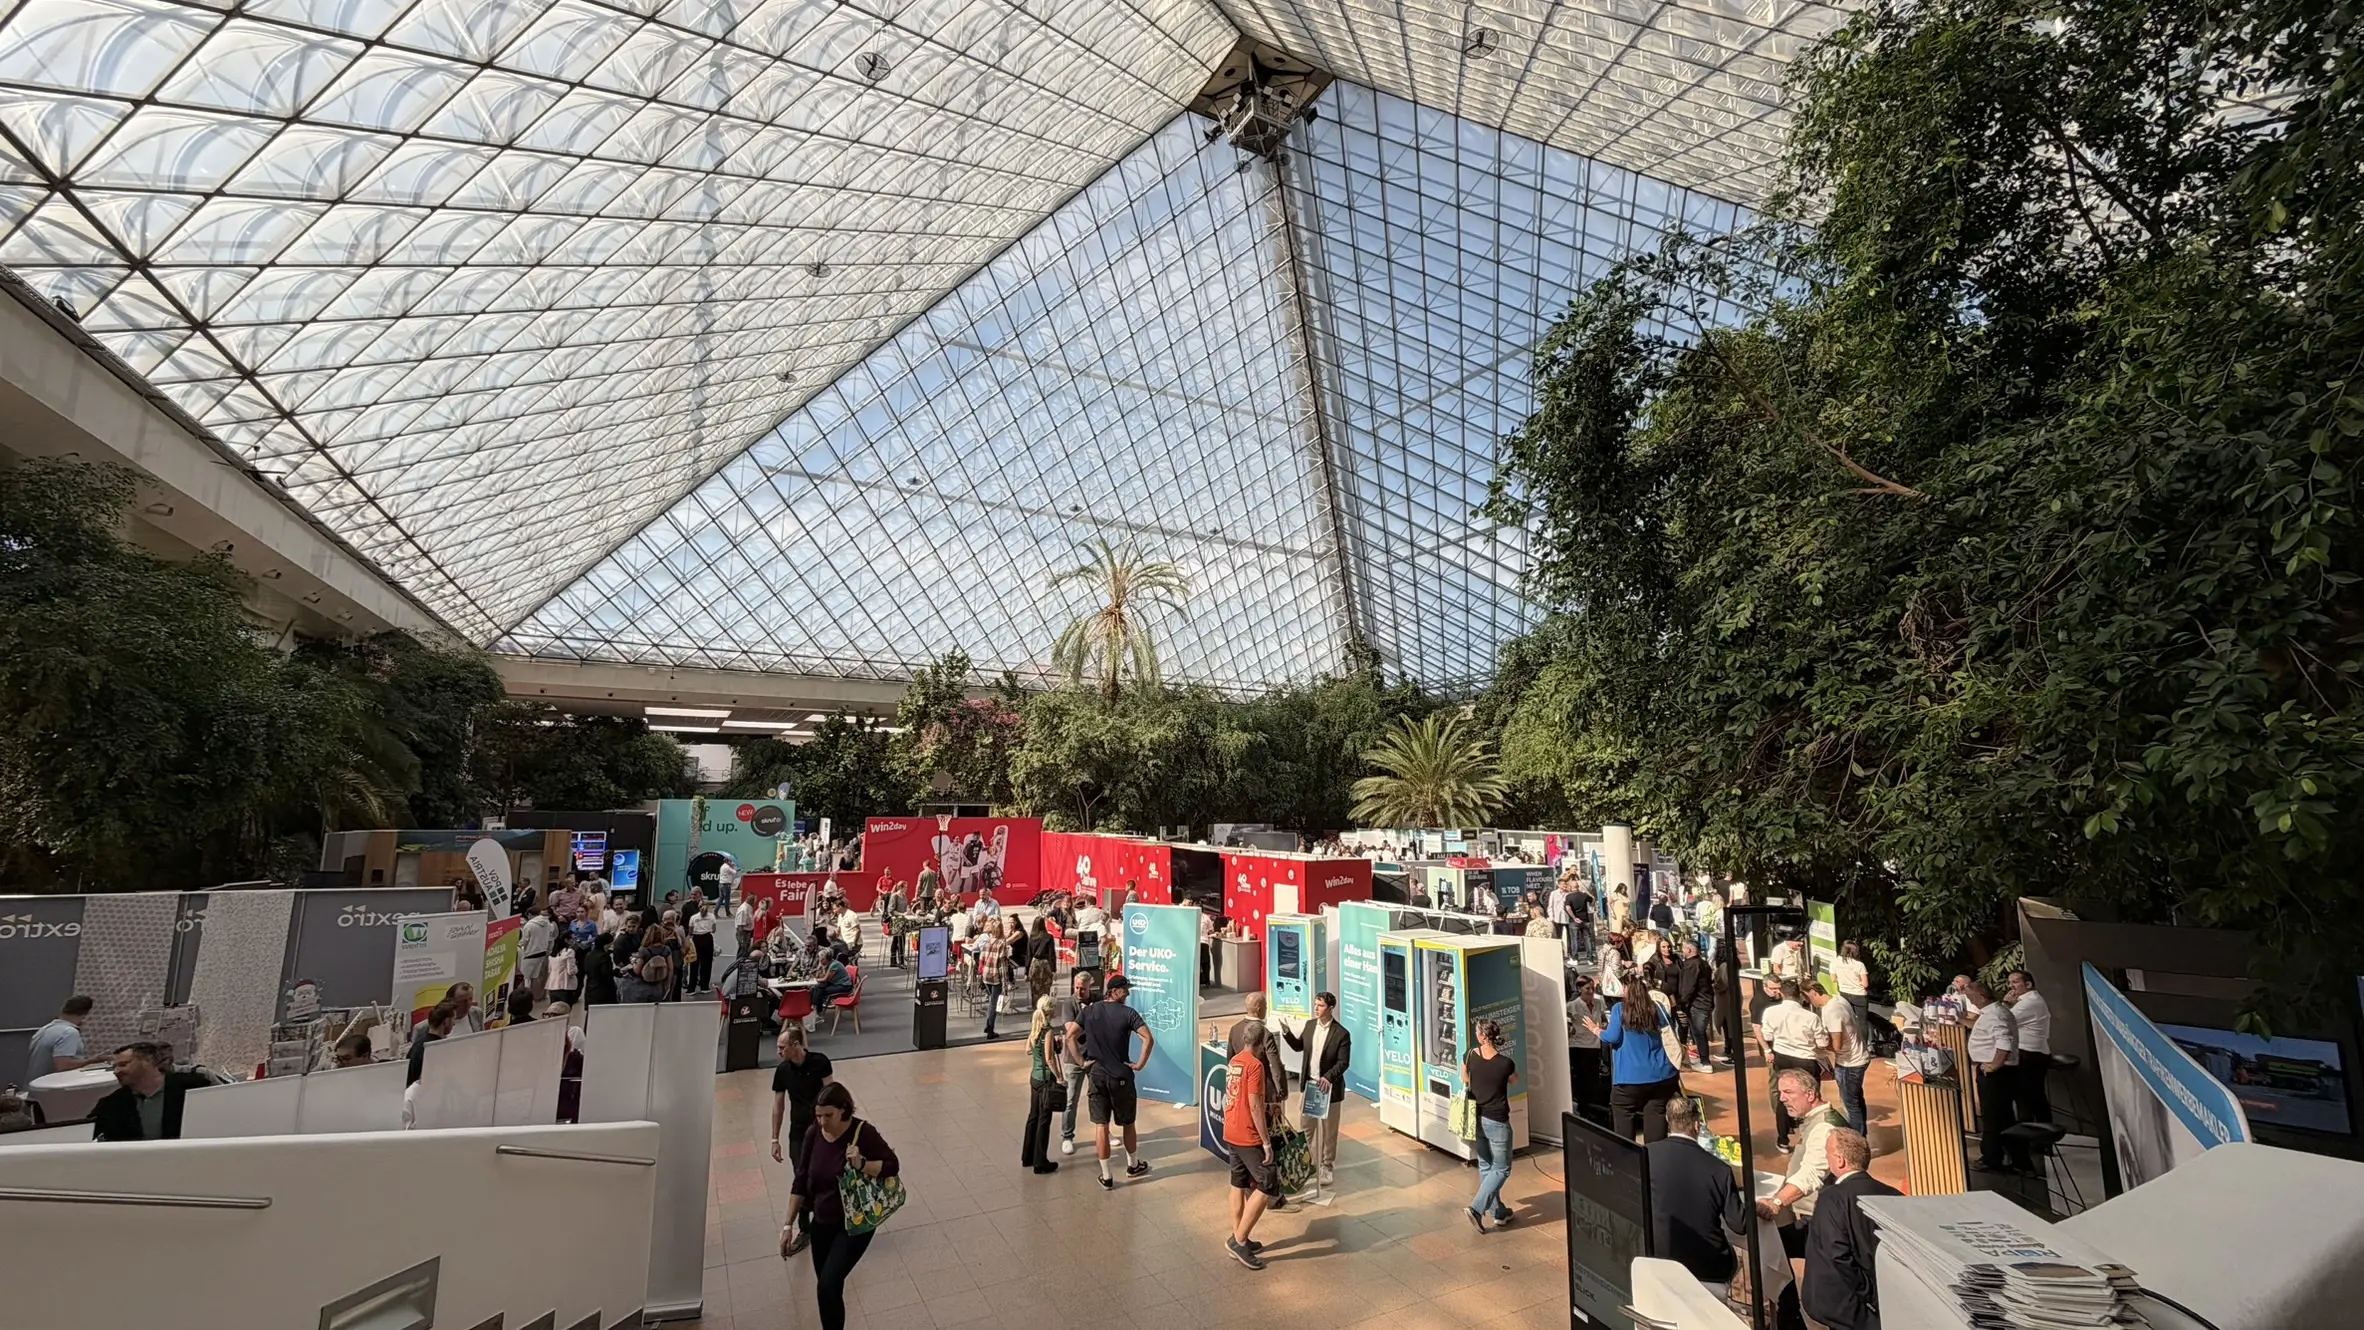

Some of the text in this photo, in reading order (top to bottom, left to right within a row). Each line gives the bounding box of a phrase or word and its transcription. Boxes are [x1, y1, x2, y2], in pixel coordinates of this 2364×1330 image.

[738, 808, 754, 817] NEW
[716, 823, 738, 834] up.
[700, 871, 721, 881] skru
[775, 878, 807, 889] Es lebe
[1128, 946, 1176, 959] Der UKO-
[1344, 943, 1376, 960] Alles aus
[1128, 959, 1169, 973] Service.
[1344, 956, 1378, 974] einer Han
[1280, 997, 1300, 1005] VELO
[1384, 1049, 1411, 1065] VELO
[1430, 1068, 1449, 1079] VELO
